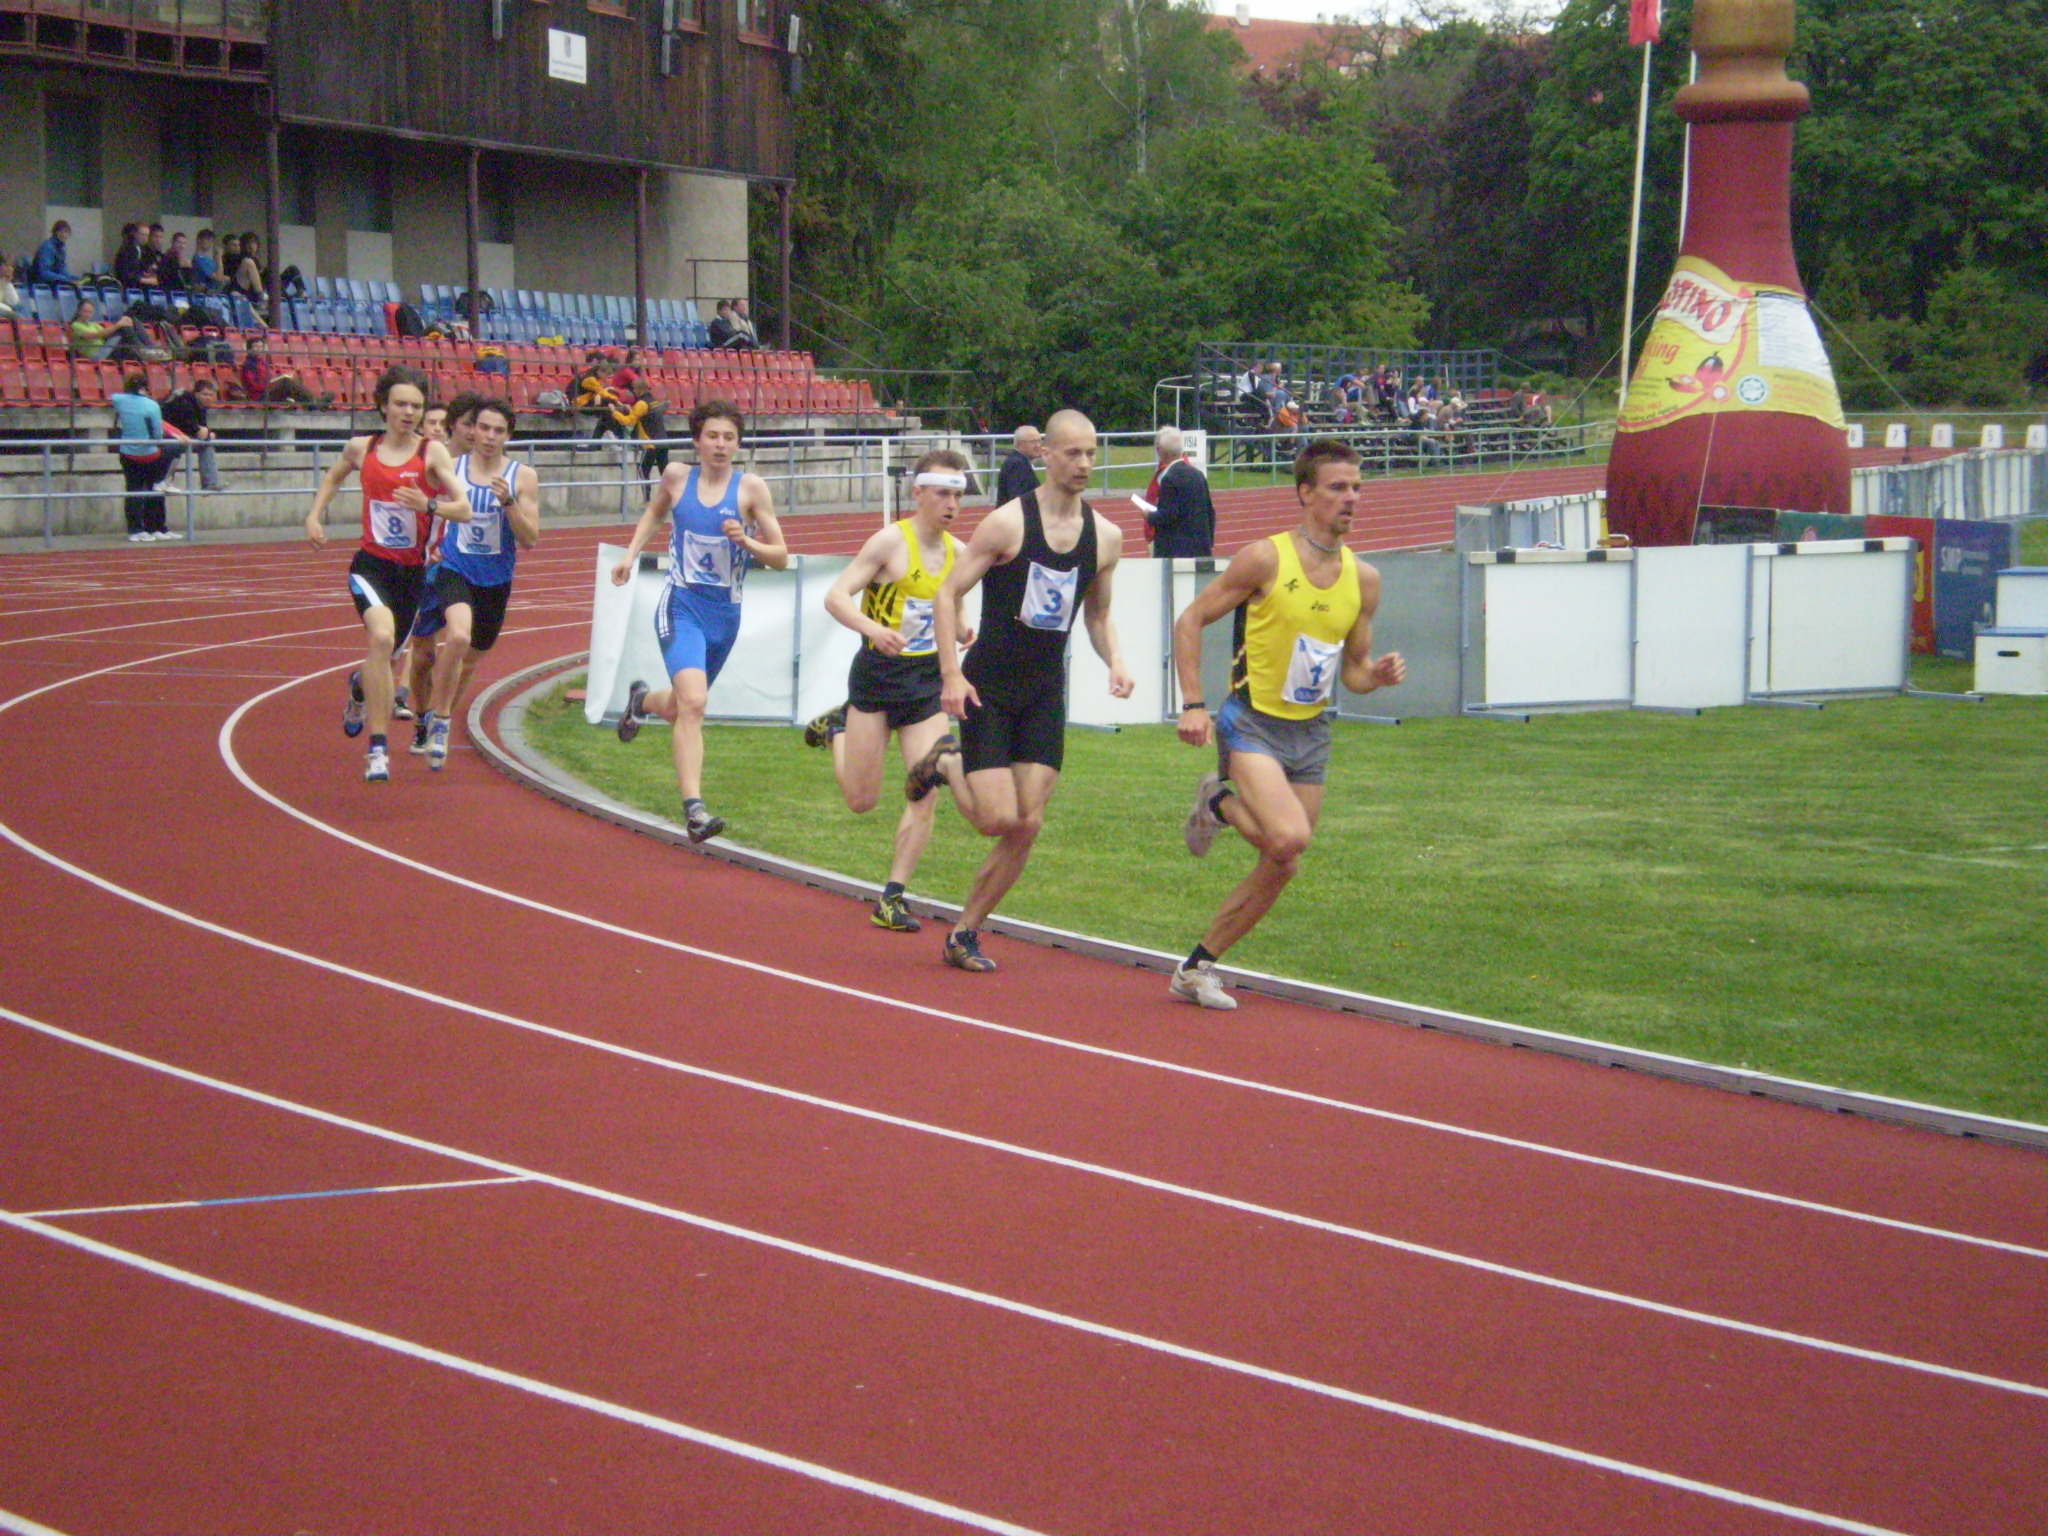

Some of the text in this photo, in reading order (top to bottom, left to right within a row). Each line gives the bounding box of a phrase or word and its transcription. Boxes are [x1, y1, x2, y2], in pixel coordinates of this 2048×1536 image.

[388, 516, 403, 536] 8
[471, 525, 485, 543] 9
[698, 551, 715, 572] 4
[1043, 588, 1063, 614] 3
[919, 614, 933, 637] 7
[1309, 661, 1324, 688] 1
